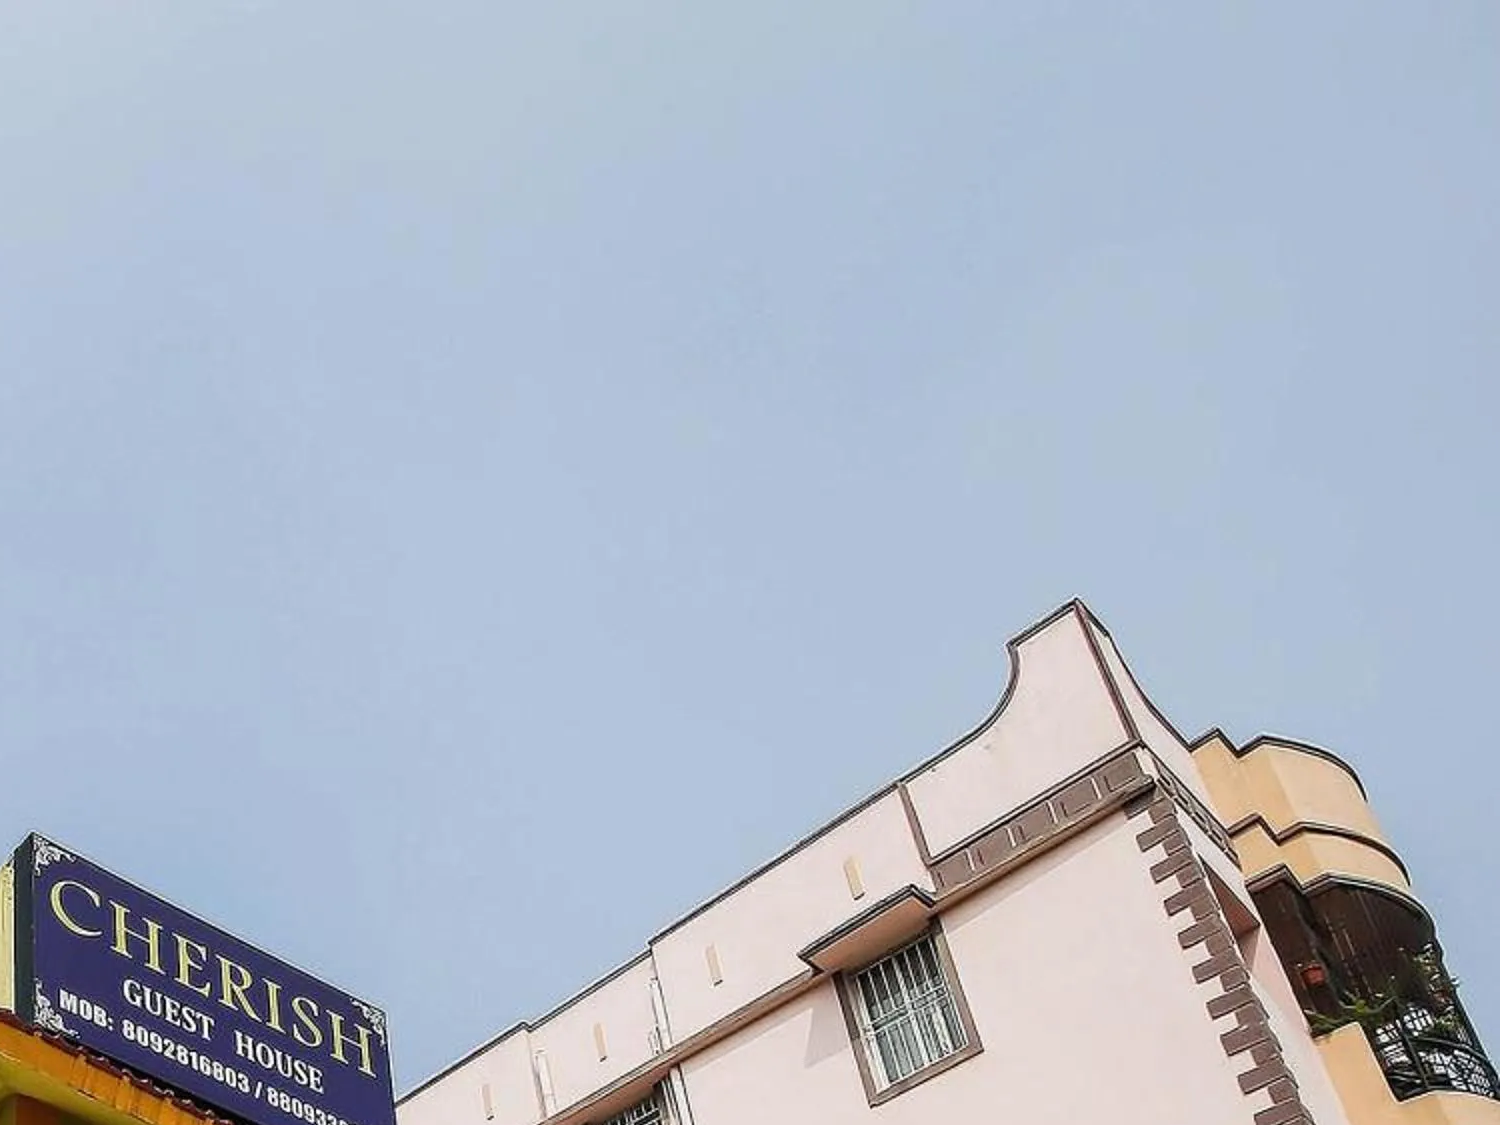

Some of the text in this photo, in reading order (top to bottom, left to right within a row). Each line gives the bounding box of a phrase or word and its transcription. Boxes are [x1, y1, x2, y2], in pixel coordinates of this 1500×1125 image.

[49, 880, 377, 1078] CHERISH
[123, 979, 325, 1094] GUEST HOUSE
[59, 989, 114, 1031] MOB:
[122, 1019, 250, 1094] 8092816803
[254, 1081, 263, 1098] /
